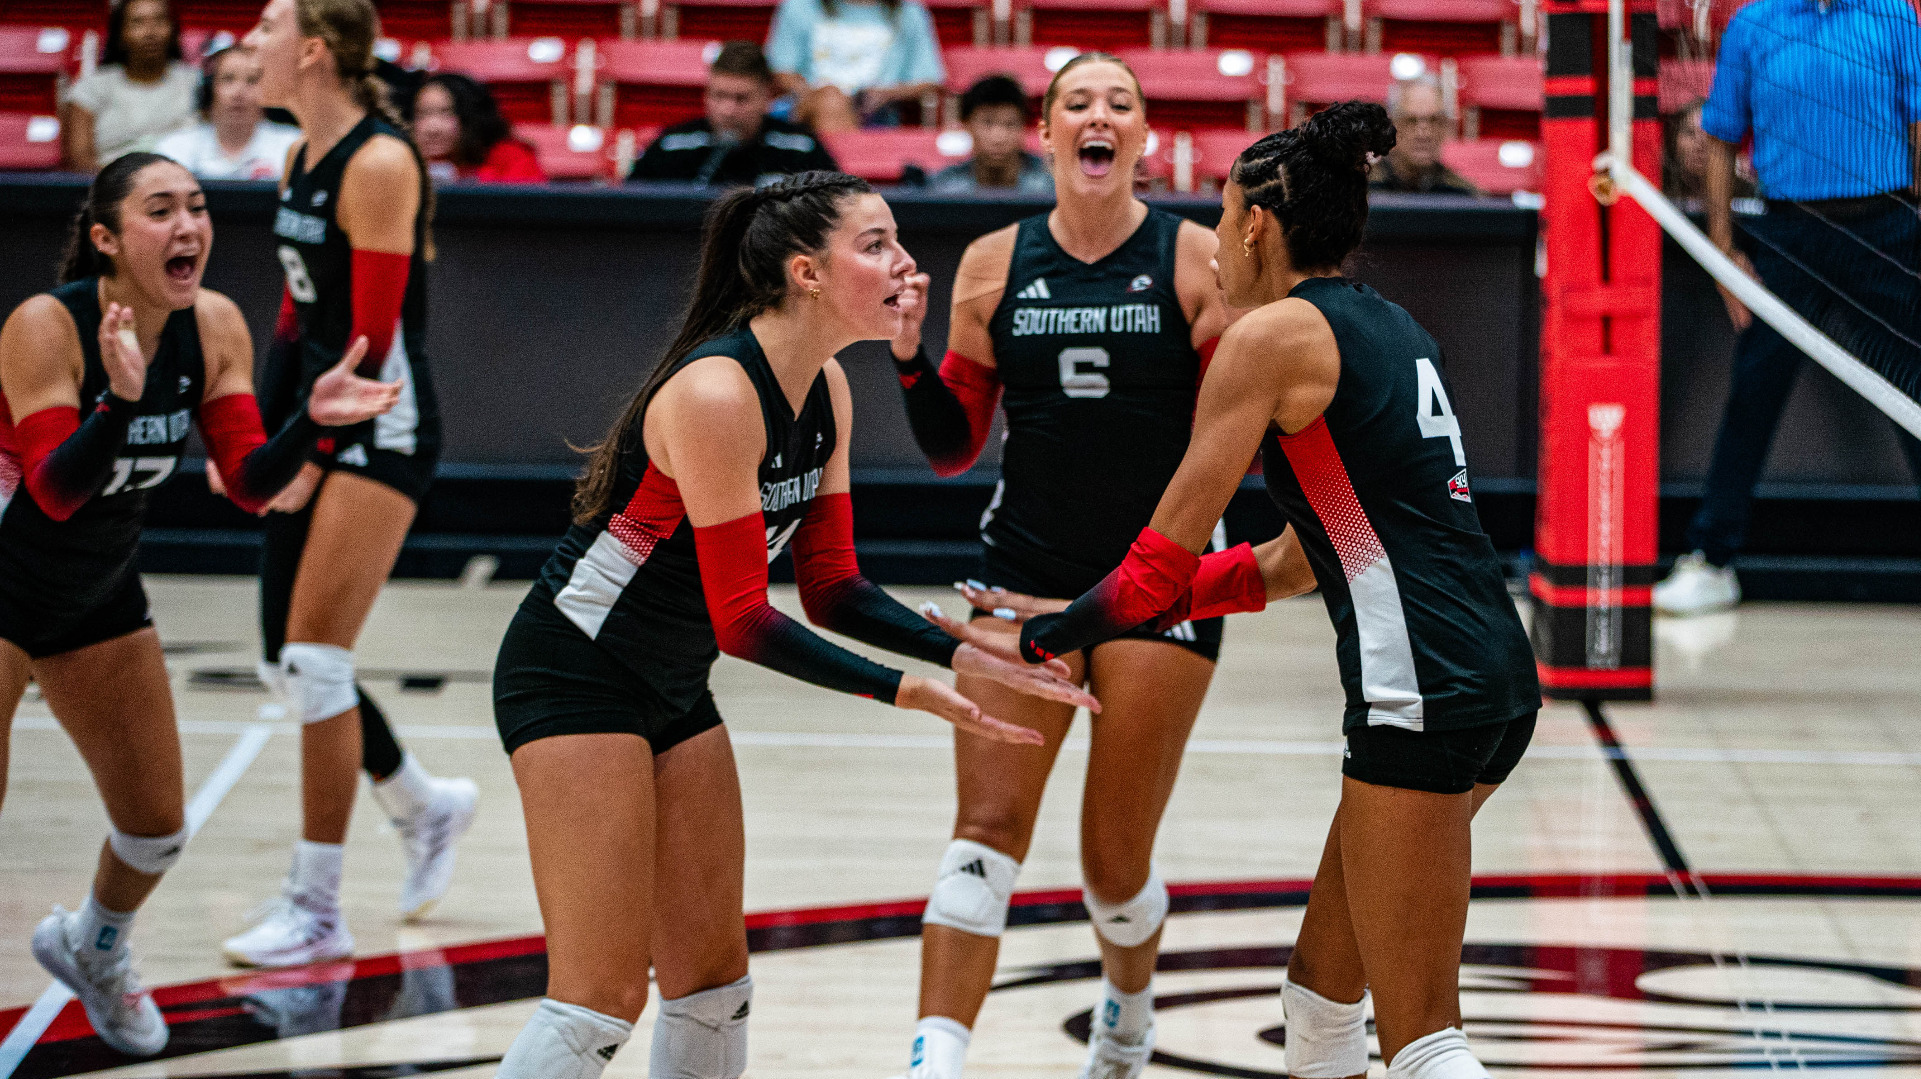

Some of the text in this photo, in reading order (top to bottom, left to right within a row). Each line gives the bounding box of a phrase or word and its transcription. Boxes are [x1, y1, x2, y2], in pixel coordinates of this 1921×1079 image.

[278, 245, 318, 303] 8
[1012, 303, 1161, 336] SOUTHERN UTAH
[1058, 347, 1110, 398] 6
[1416, 358, 1466, 466] 4
[102, 456, 176, 497] 17
